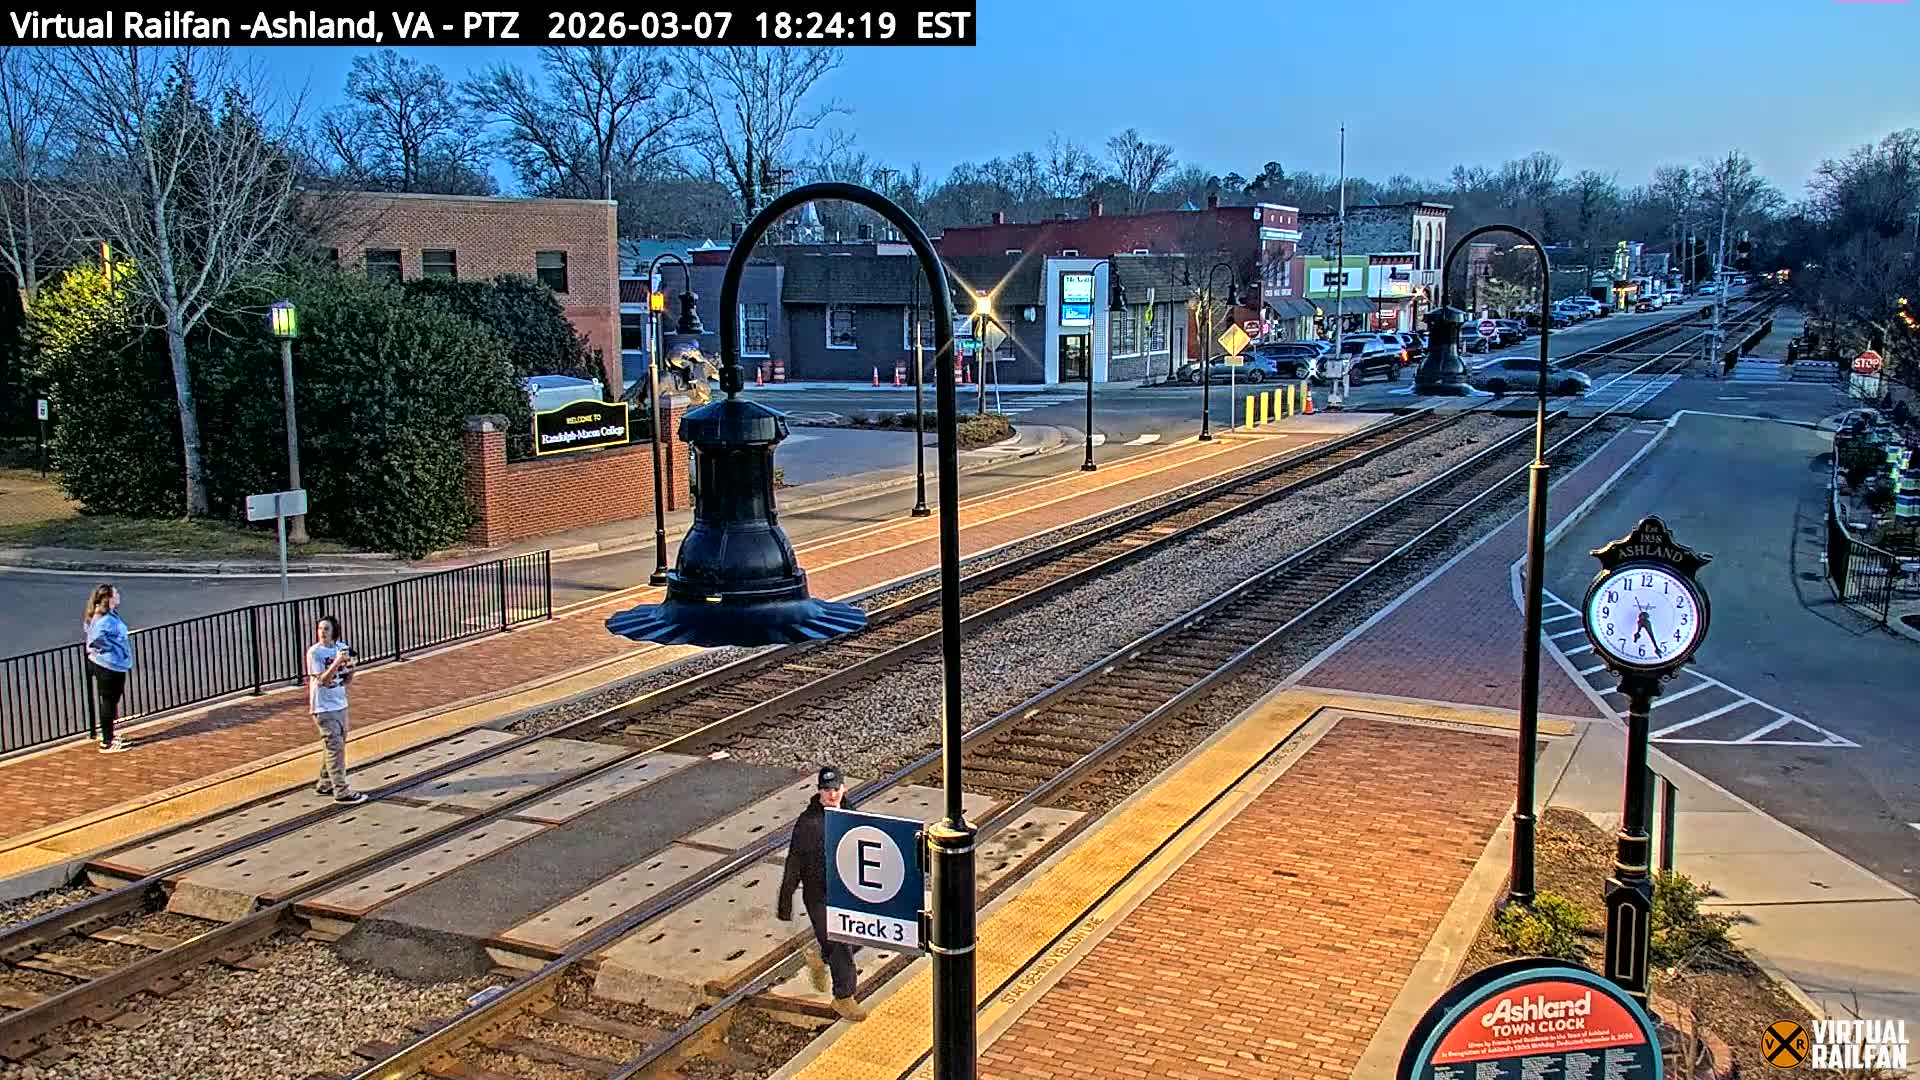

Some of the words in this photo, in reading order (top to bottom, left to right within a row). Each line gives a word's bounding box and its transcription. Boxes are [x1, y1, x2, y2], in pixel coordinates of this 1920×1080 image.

[1855, 358, 1879, 368] STOP
[1618, 544, 1683, 563] ASHLAND
[1623, 578, 1632, 591] 11
[1641, 575, 1653, 588] 12
[1664, 582, 1669, 595] 1
[1607, 590, 1618, 604] 10
[1676, 596, 1684, 609] 2
[1602, 606, 1610, 619] 9
[1680, 614, 1688, 626] 3
[1606, 623, 1614, 636] 8
[1673, 629, 1681, 643] 4
[1618, 638, 1626, 652] 7
[1638, 644, 1646, 657] 6
[858, 840, 882, 889] E
[838, 913, 887, 938] Track
[893, 923, 904, 942] 3
[1481, 990, 1591, 1027] Ashland
[1492, 1022, 1535, 1037] TOWN
[1539, 1017, 1585, 1033] CLOCK
